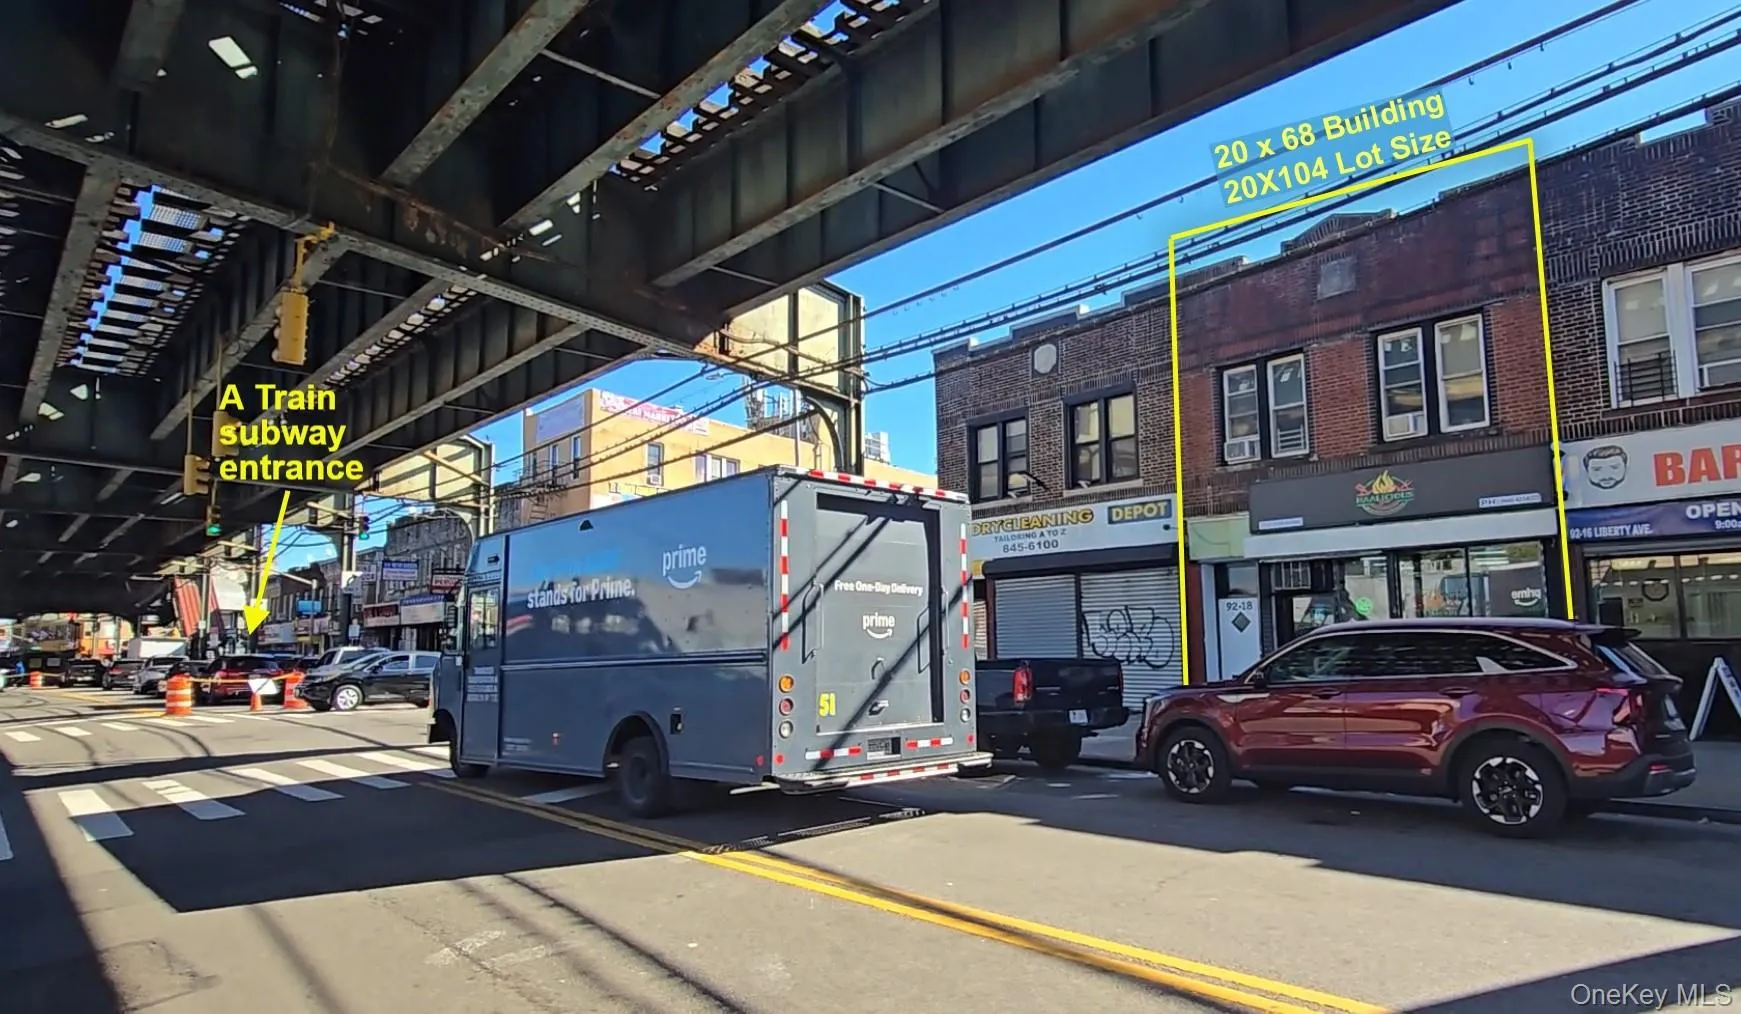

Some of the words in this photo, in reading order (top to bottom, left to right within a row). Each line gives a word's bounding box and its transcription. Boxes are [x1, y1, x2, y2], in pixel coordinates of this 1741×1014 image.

[1111, 503, 1168, 522] DEPOT
[1686, 502, 1741, 519] OPEN
[994, 531, 1037, 543] TAILORING
[1039, 530, 1046, 538] A
[1047, 529, 1060, 538] TO
[1060, 528, 1067, 536] Z
[1594, 525, 1632, 537] LIBERTY
[1002, 538, 1059, 553] 845-6100
[663, 544, 707, 576] prime
[527, 584, 568, 609] stands
[569, 582, 588, 604] for
[591, 576, 636, 601] Prime.
[834, 580, 855, 591] Free
[855, 581, 891, 595] One-Day
[891, 583, 924, 597] Delivery
[862, 612, 896, 630] prime
[818, 692, 836, 717] 51
